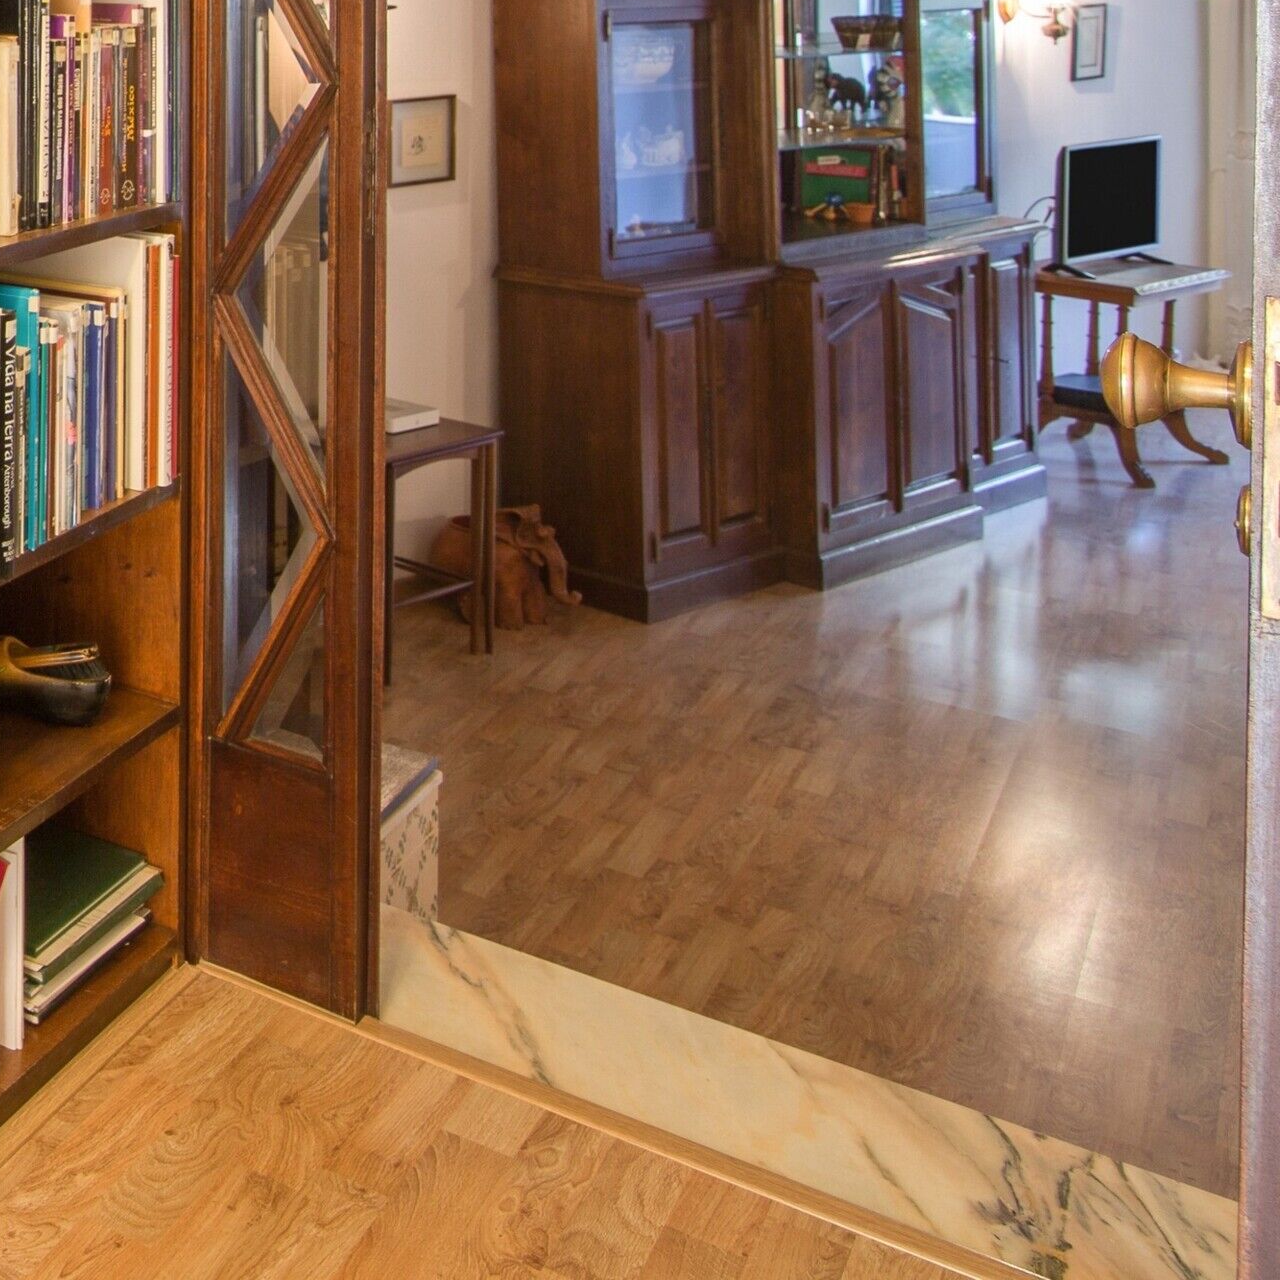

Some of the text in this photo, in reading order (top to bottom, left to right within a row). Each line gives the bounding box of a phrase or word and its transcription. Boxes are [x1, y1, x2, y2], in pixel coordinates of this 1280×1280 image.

[126, 85, 134, 142] México
[3, 344, 16, 461] Vida na Terra
[2, 462, 12, 530] Attenborough
